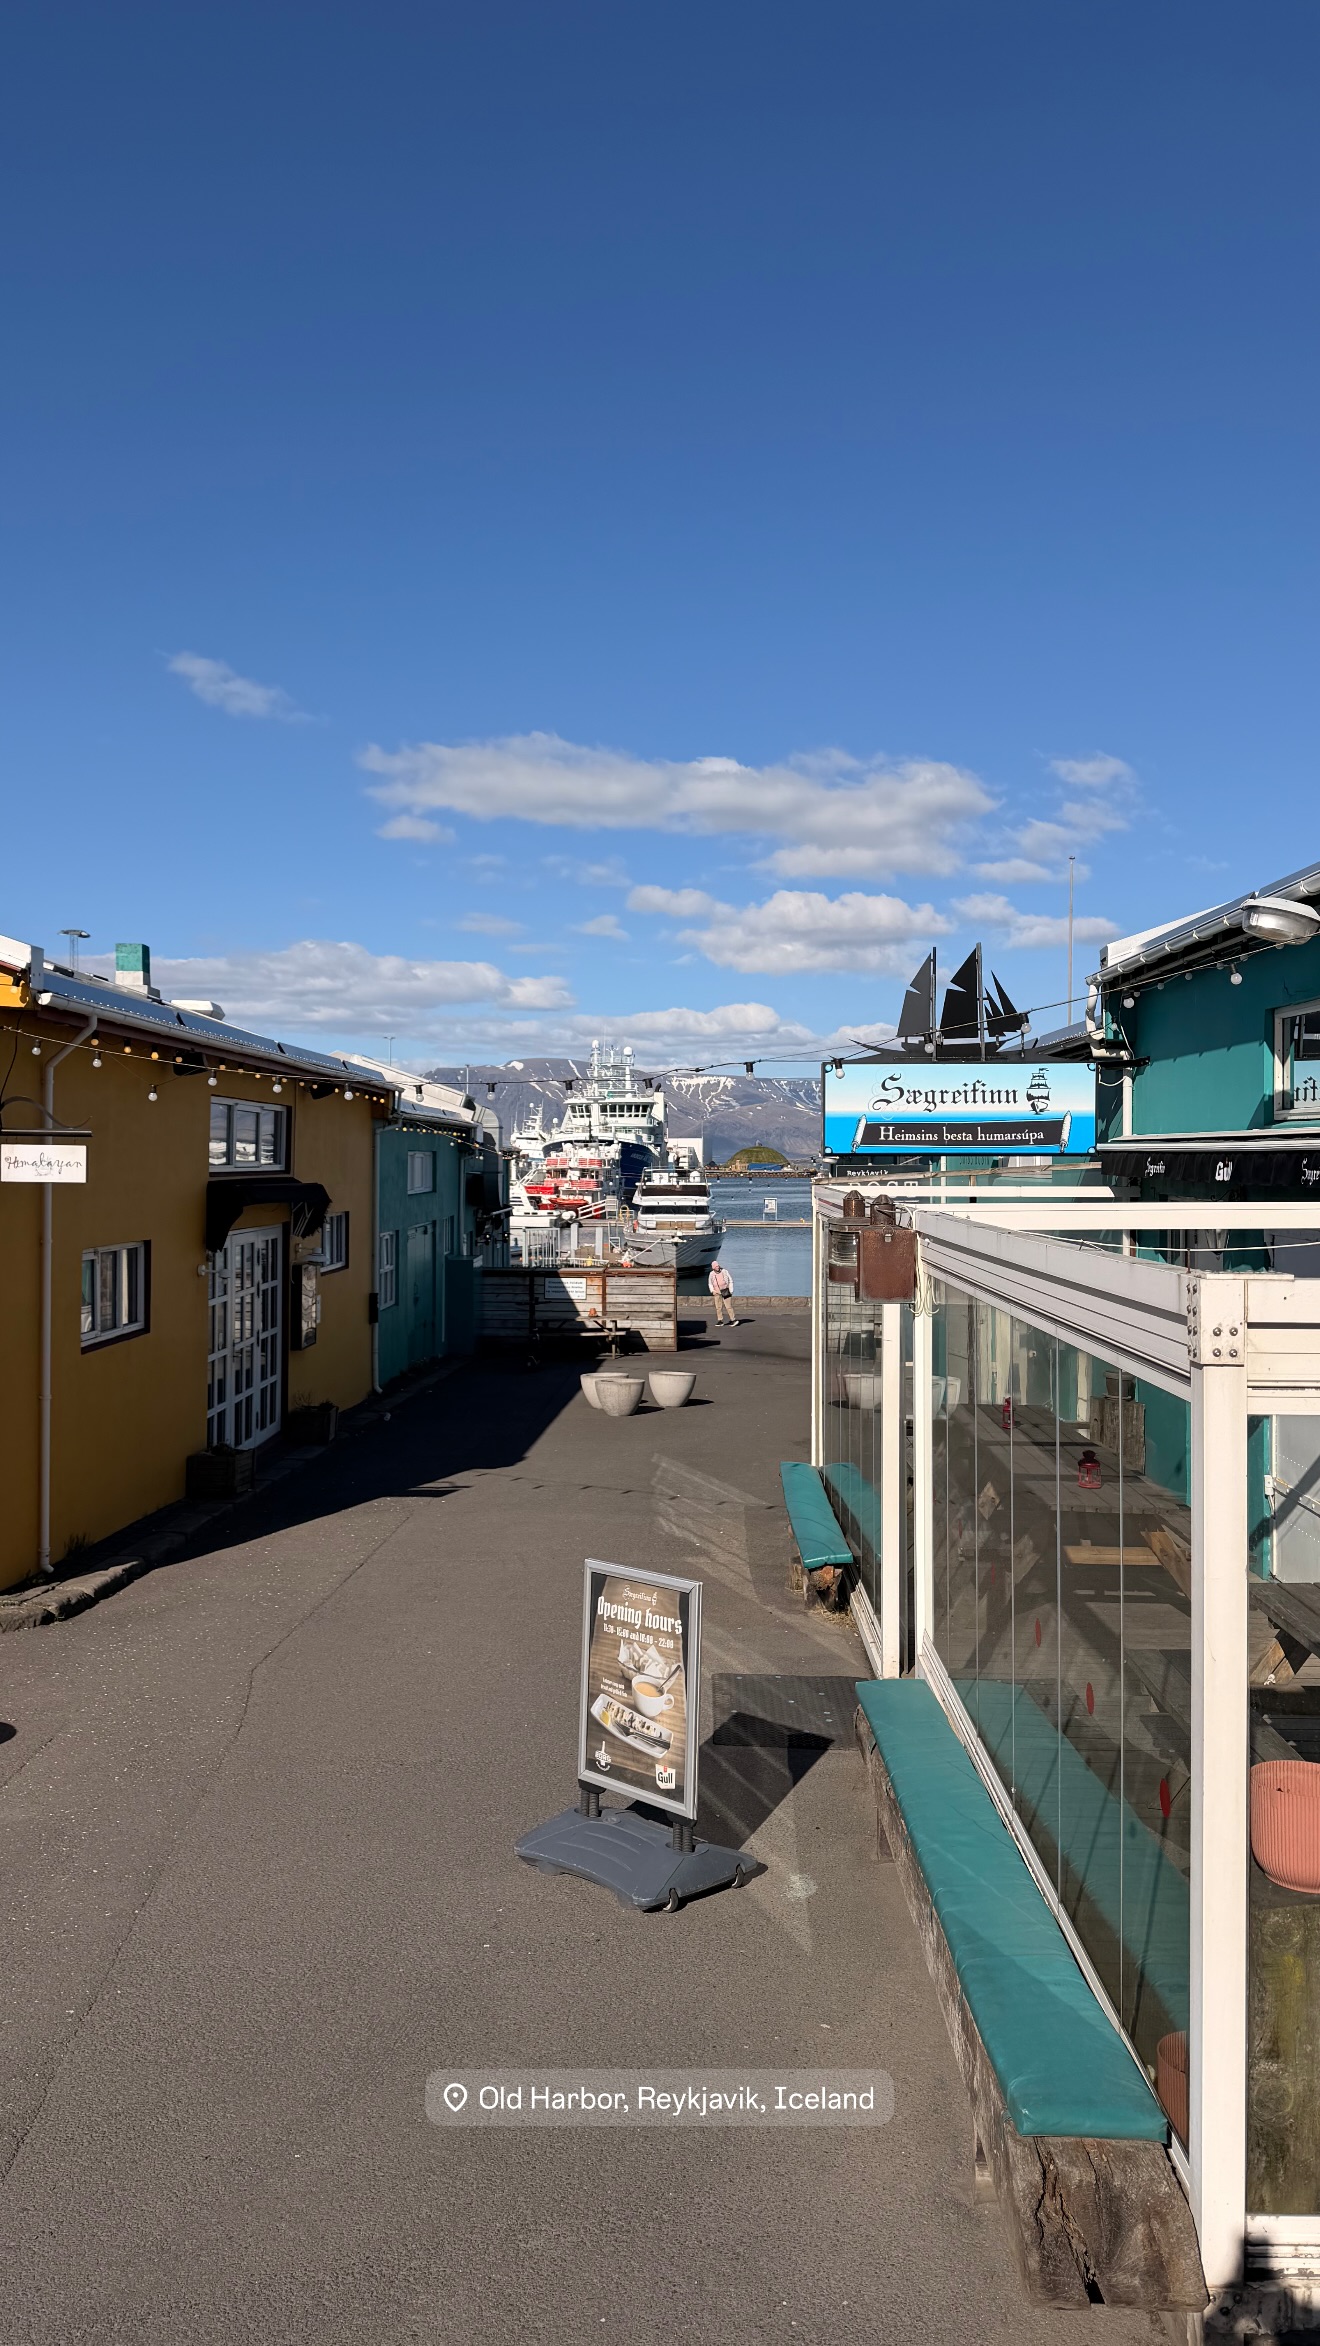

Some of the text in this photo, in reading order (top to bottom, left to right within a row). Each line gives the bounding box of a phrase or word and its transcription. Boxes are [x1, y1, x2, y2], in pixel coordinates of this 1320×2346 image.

[872, 1073, 1018, 1112] Sægreifinn
[879, 1126, 1044, 1145] Heimsins besta humarsúpa
[597, 1596, 683, 1635] Opening hours
[657, 1771, 673, 1784] Gull
